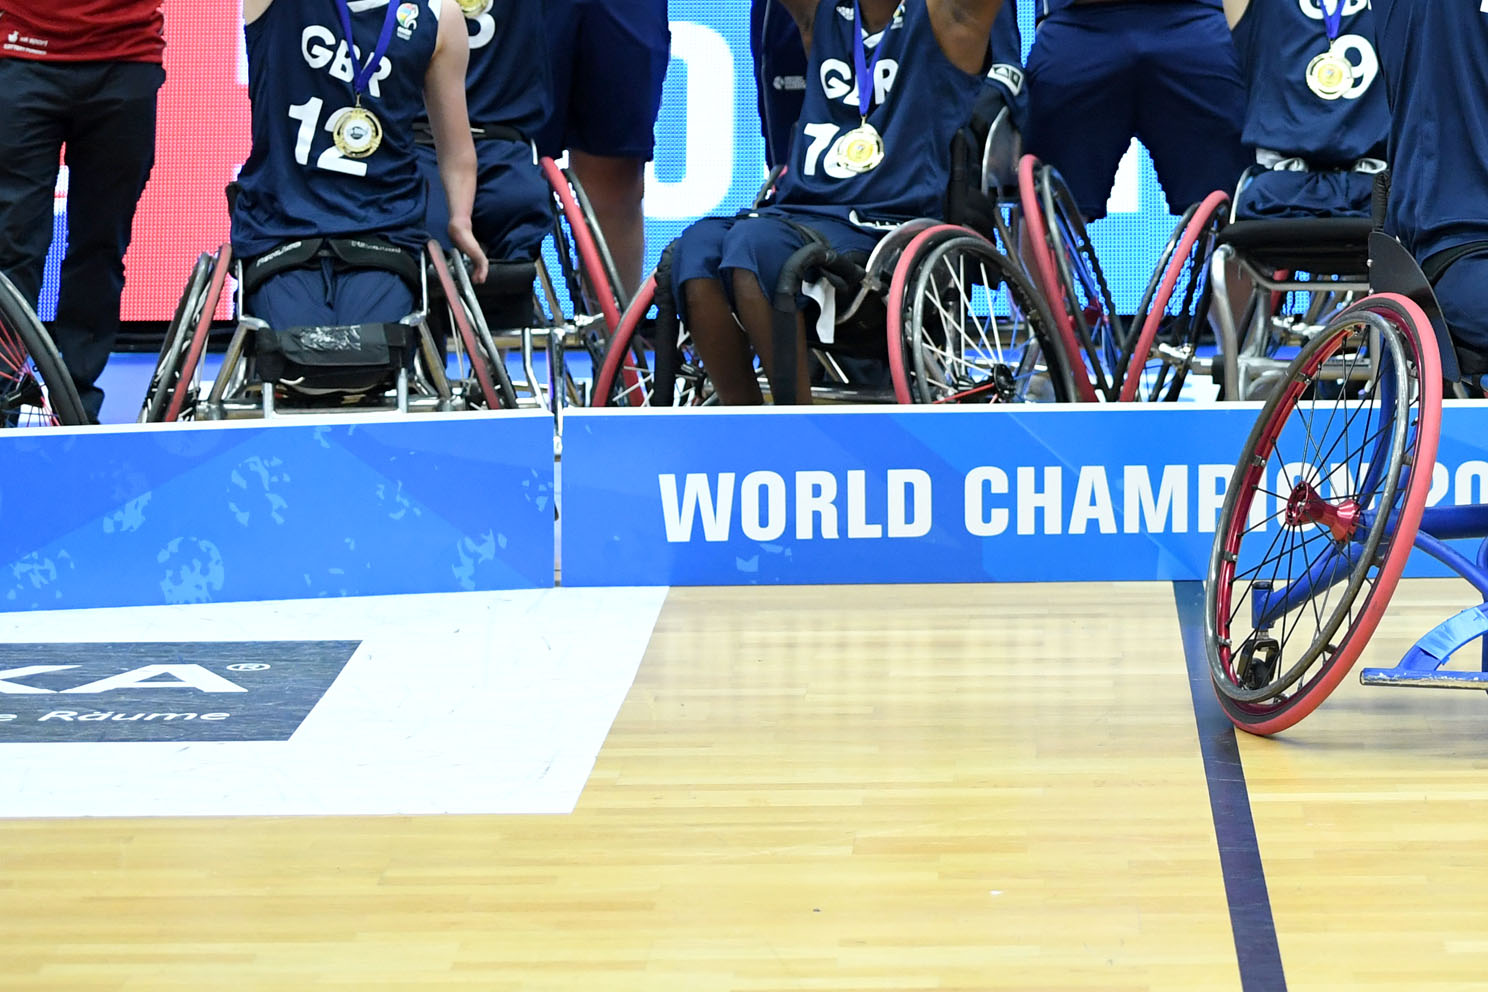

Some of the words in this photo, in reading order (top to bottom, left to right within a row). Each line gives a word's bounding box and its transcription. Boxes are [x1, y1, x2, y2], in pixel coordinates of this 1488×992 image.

[301, 24, 392, 98] GBR
[819, 58, 899, 106] GR
[288, 96, 368, 177] 12
[658, 468, 933, 543] WORLD
